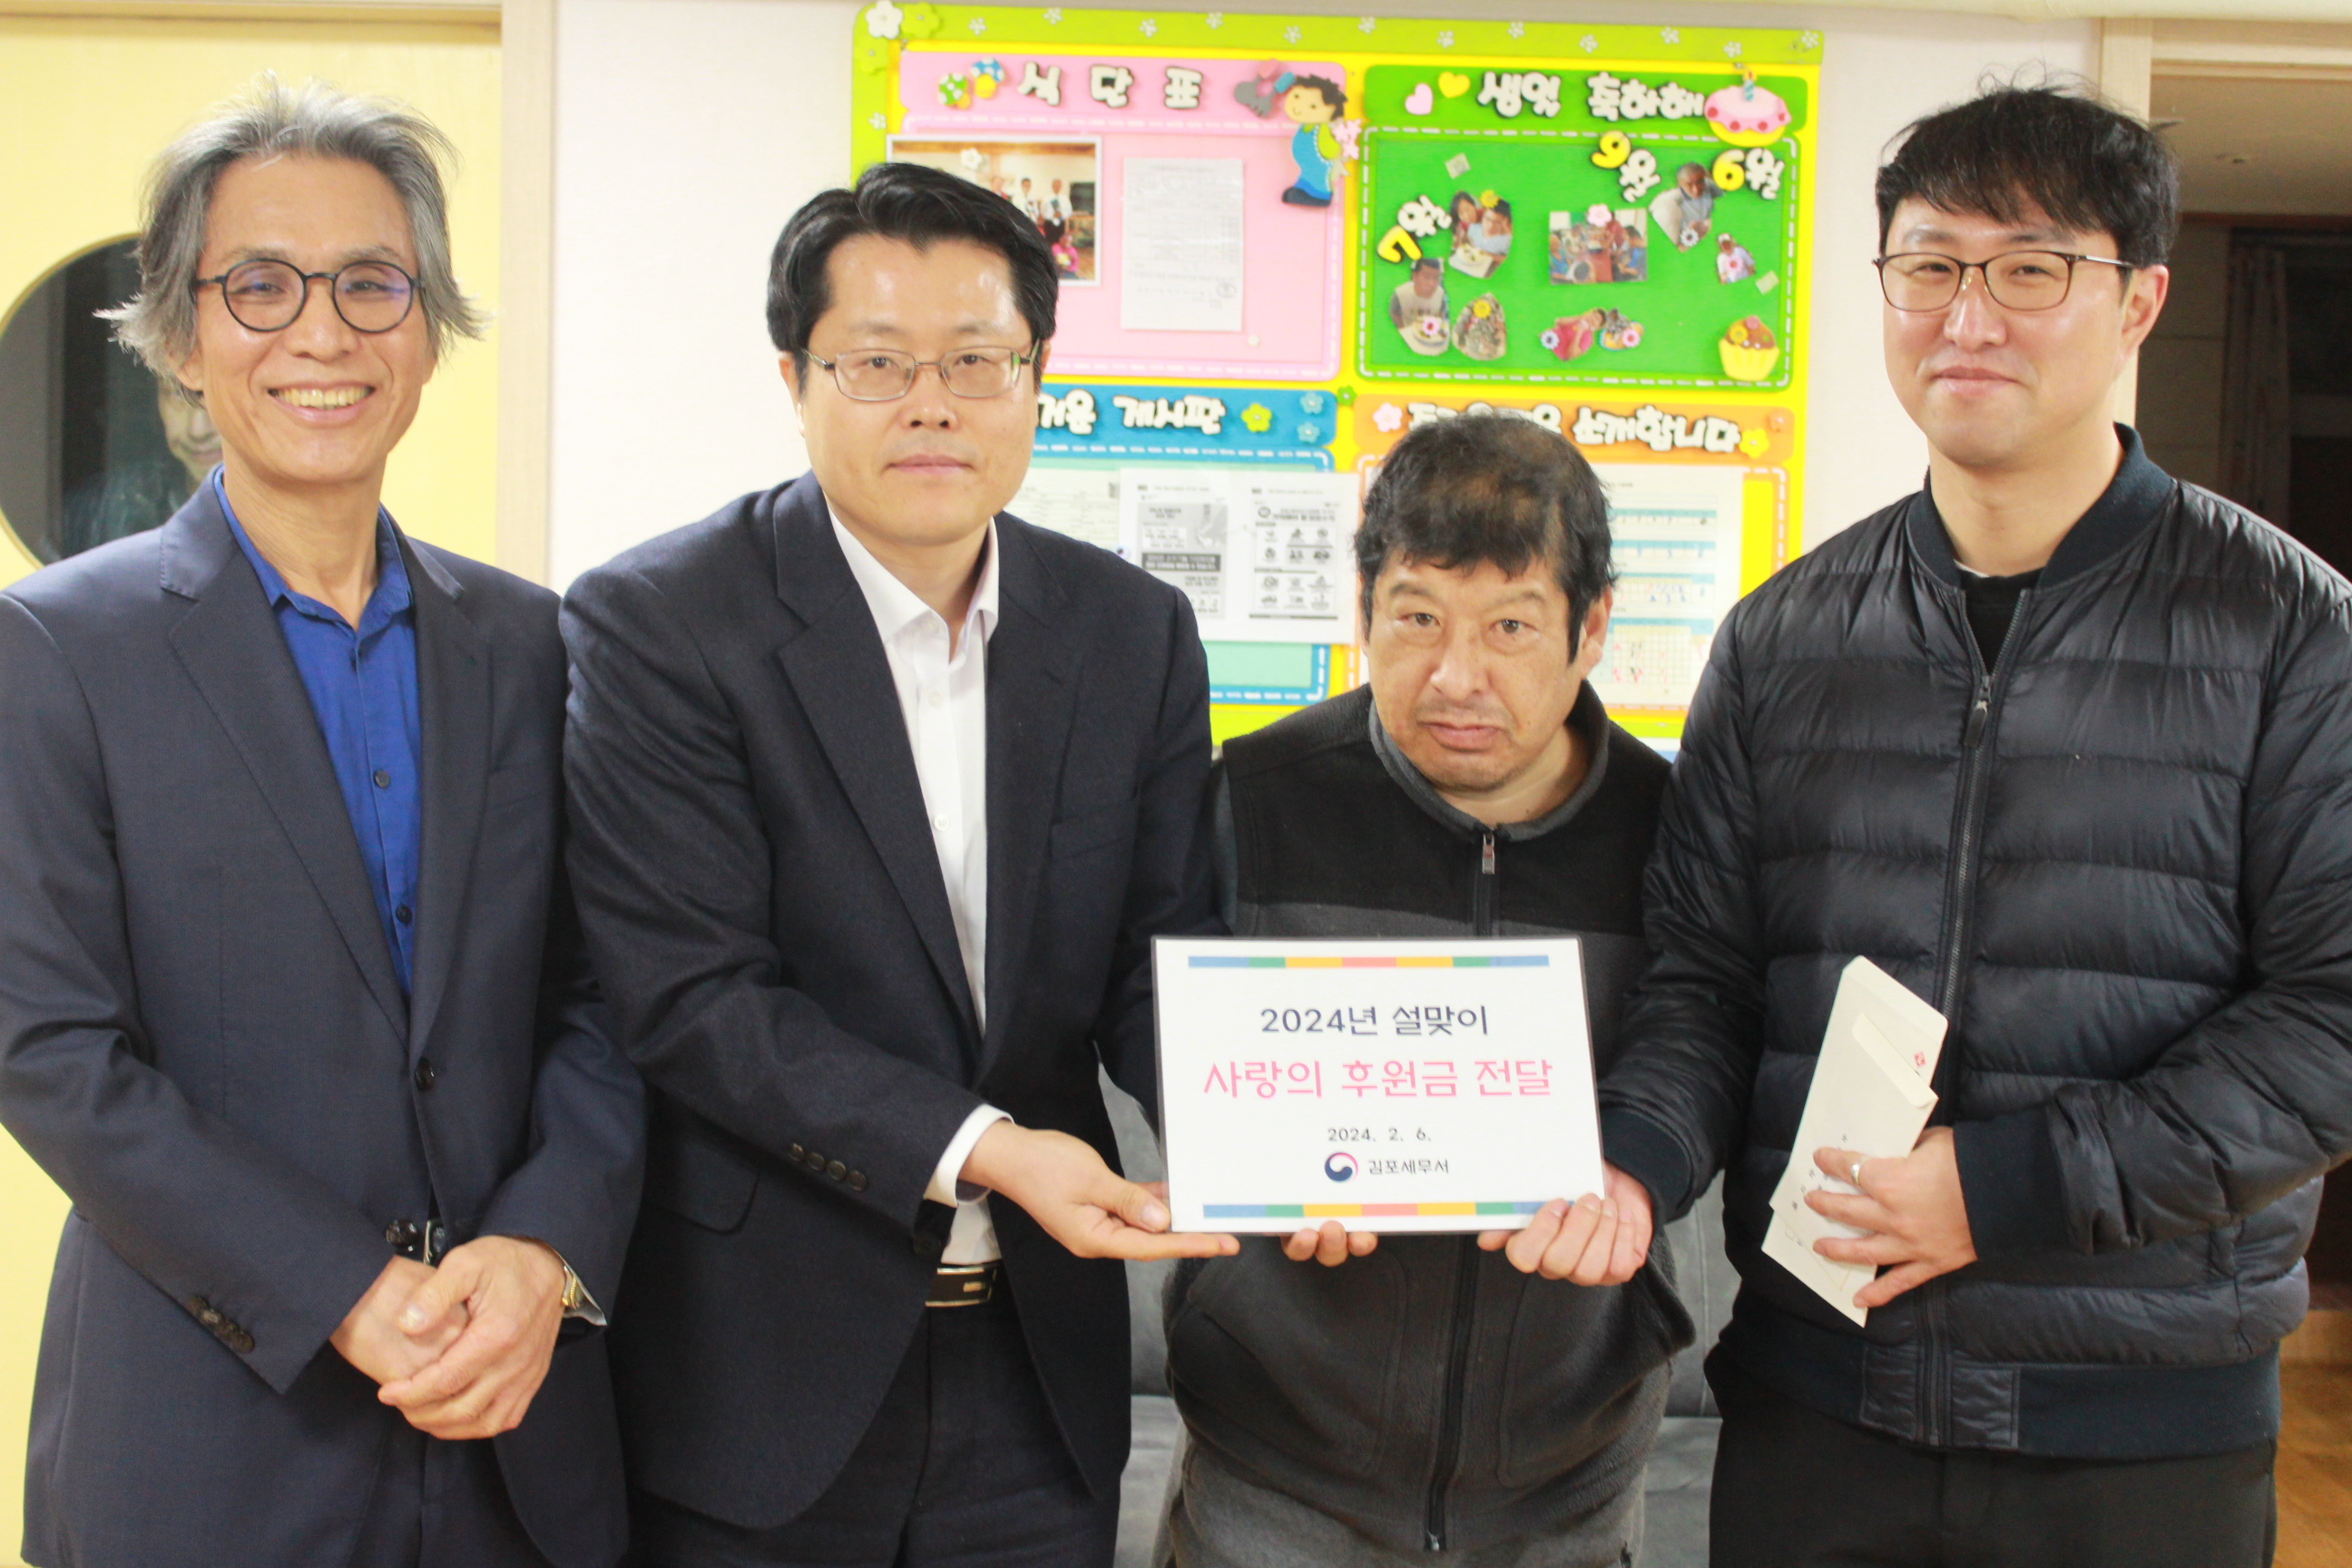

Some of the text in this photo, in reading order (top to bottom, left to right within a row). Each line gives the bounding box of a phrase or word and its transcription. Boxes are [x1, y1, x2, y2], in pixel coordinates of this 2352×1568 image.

[1476, 70, 1561, 118] 생일
[1112, 394, 1227, 436] 게시판
[1572, 404, 1742, 453] 소개합니다
[1259, 1004, 1489, 1036] 2024년 설맞이
[1202, 1059, 1553, 1099] 사랑의 후원금 전달
[1327, 1126, 1432, 1142] 2024. 2. 6.
[1367, 1157, 1450, 1175] 김포세무서
